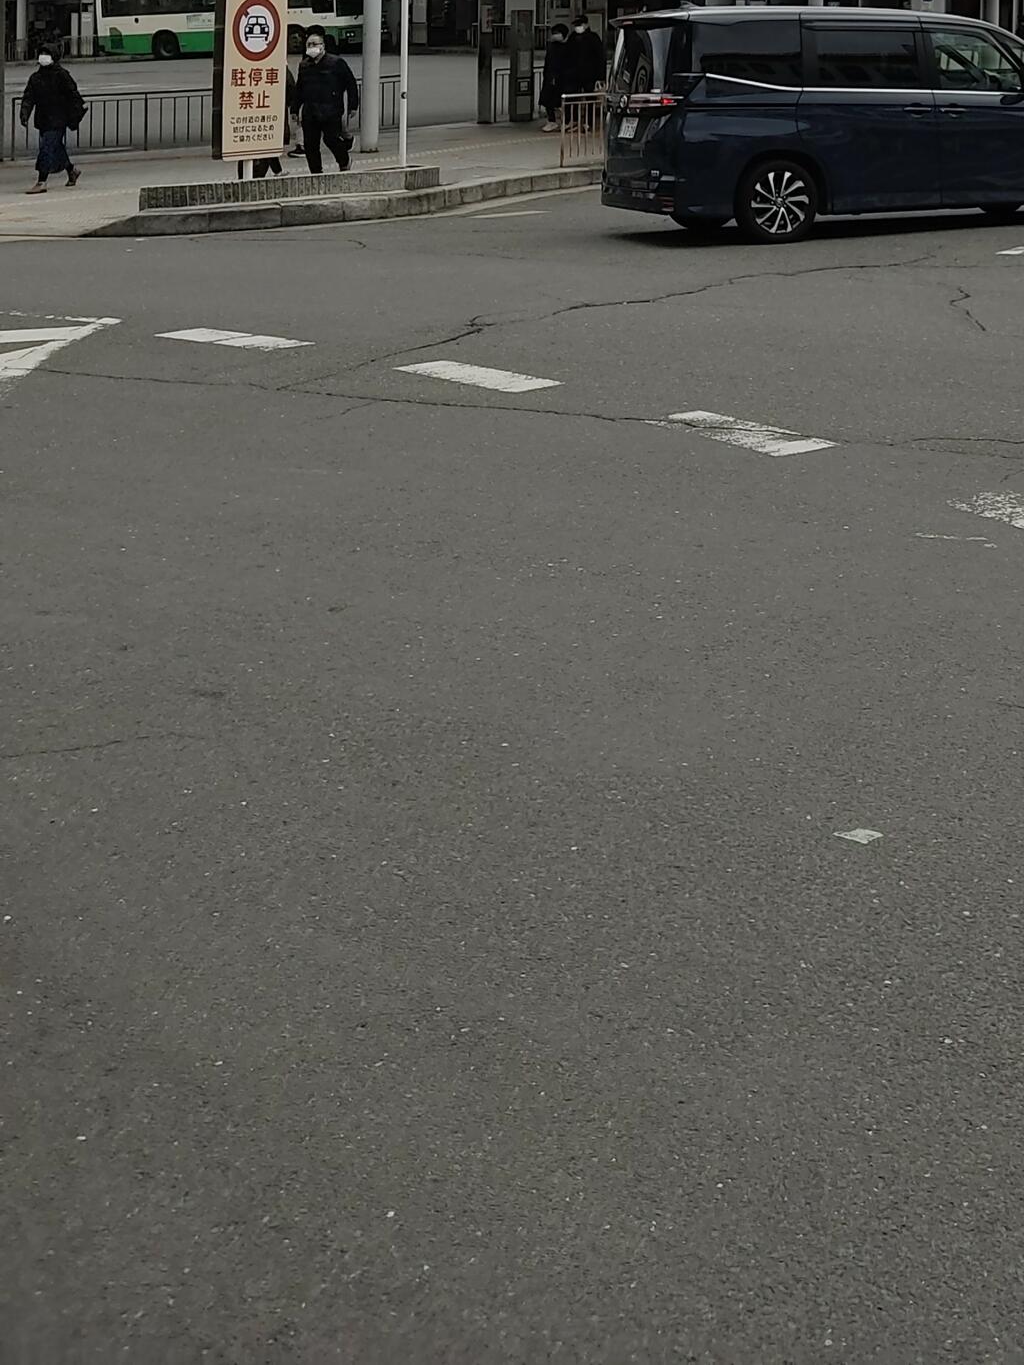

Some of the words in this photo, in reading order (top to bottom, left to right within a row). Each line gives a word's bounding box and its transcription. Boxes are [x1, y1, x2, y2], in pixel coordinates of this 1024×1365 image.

[231, 67, 280, 87] 駐停車
[239, 90, 270, 110] 禁止
